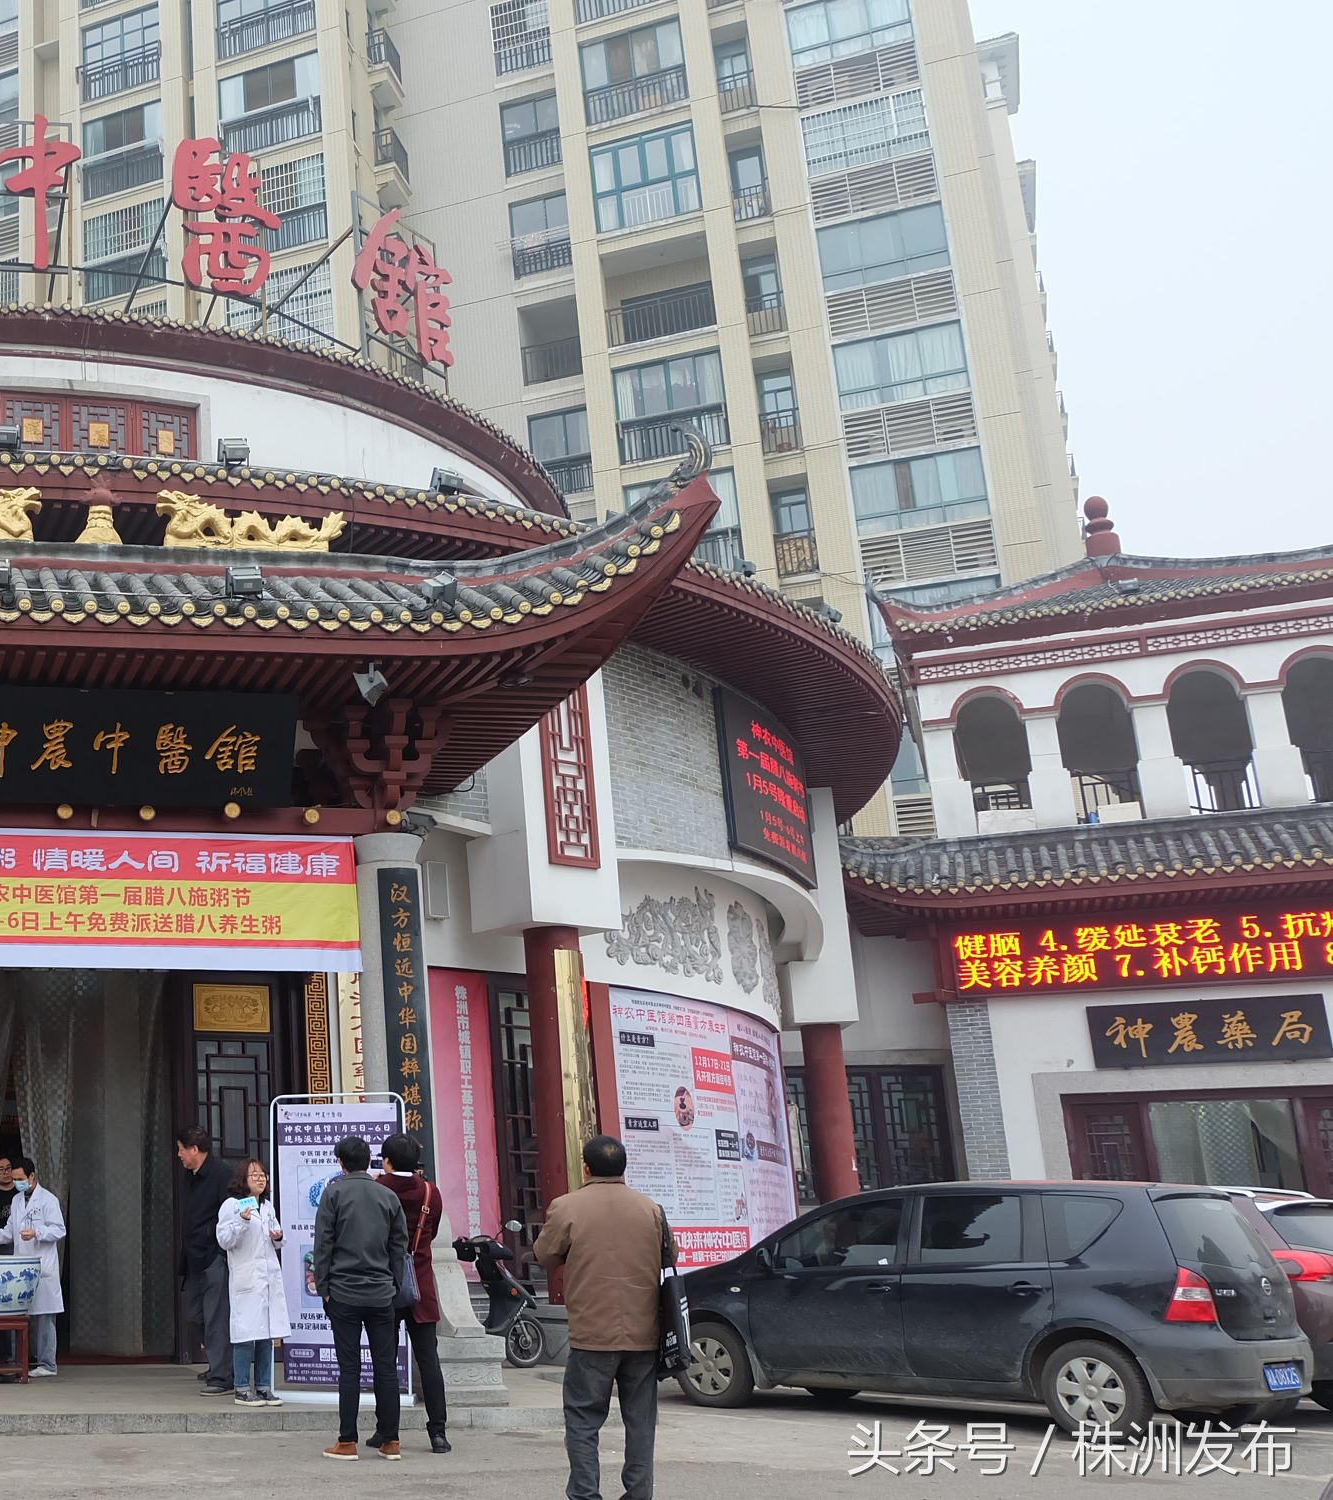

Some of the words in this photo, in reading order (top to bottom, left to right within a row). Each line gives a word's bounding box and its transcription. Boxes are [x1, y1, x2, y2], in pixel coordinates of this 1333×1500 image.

[32, 848, 179, 874] 情暖人间
[195, 850, 340, 878] 祈福健康
[954, 932, 1021, 960] 健脑
[958, 951, 1099, 990] 美容养颜
[1115, 940, 1303, 978] 7.补钙作用
[390, 882, 425, 1178] 汉方恒远中华国粹堪称
[1105, 1010, 1313, 1058] 神農藥局
